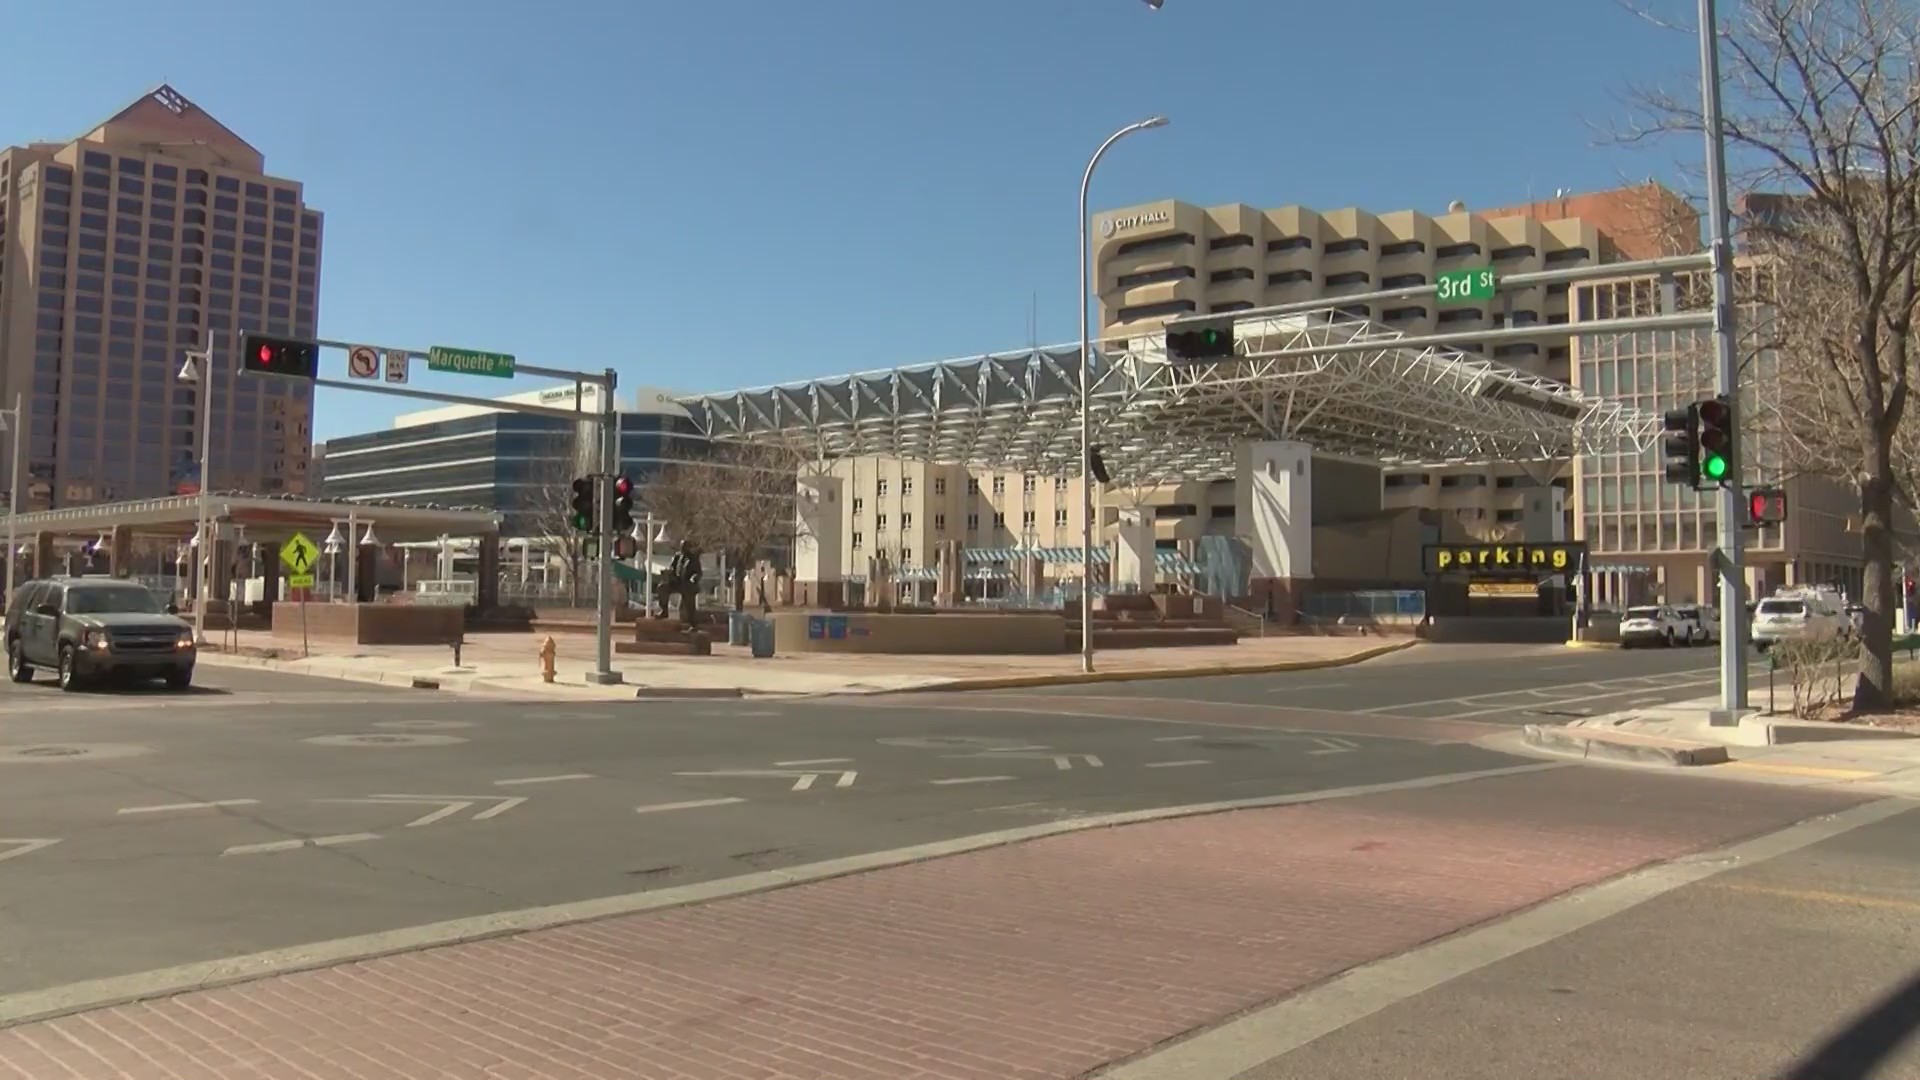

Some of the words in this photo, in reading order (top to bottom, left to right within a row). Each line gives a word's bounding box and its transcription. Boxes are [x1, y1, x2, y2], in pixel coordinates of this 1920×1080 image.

[1115, 215, 1139, 229] CITY
[1141, 210, 1168, 223] HALL
[1438, 274, 1472, 298] 3rd
[1480, 271, 1494, 288] St
[430, 348, 494, 371] Marquette
[1438, 546, 1568, 569] parking
